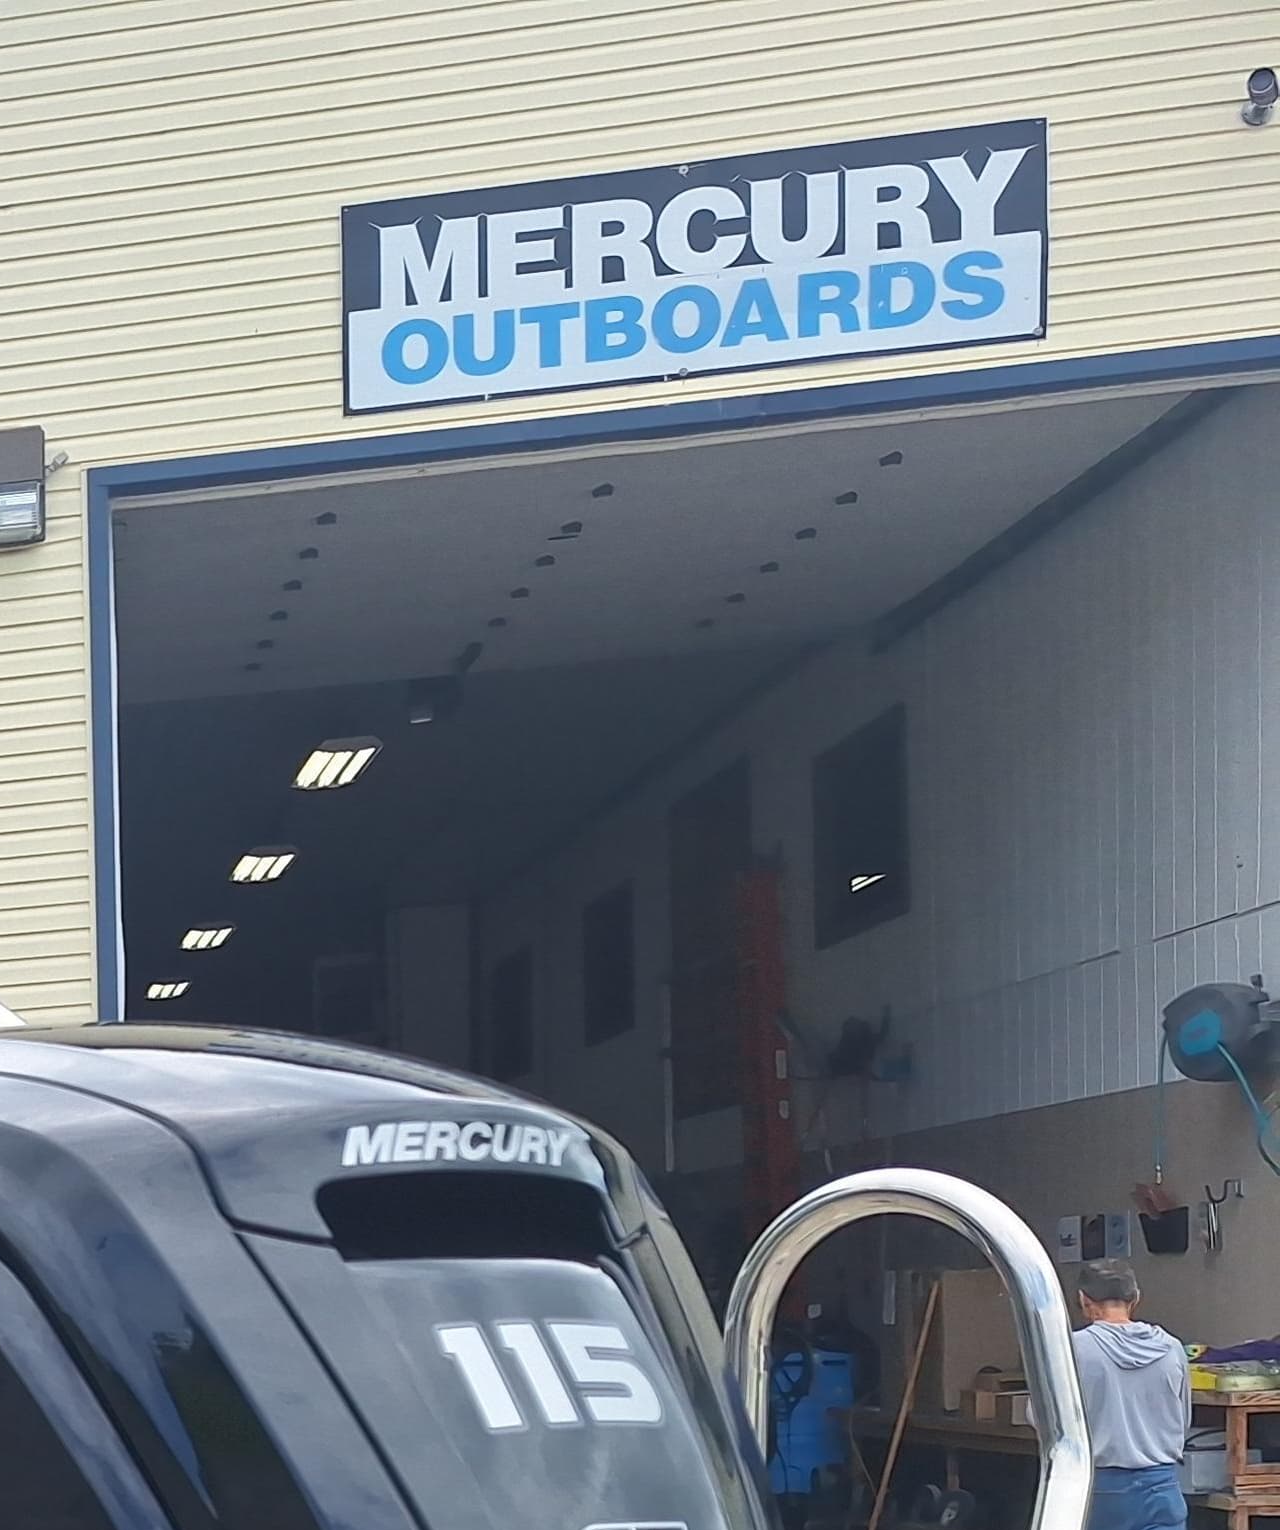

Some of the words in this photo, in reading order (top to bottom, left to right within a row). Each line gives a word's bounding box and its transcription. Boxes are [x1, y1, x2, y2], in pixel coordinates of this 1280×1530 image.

[370, 144, 1036, 310] MERCURY
[380, 250, 1005, 385] OUTBOARDS
[341, 1120, 572, 1167] MERCURY
[435, 1320, 664, 1432] 115
